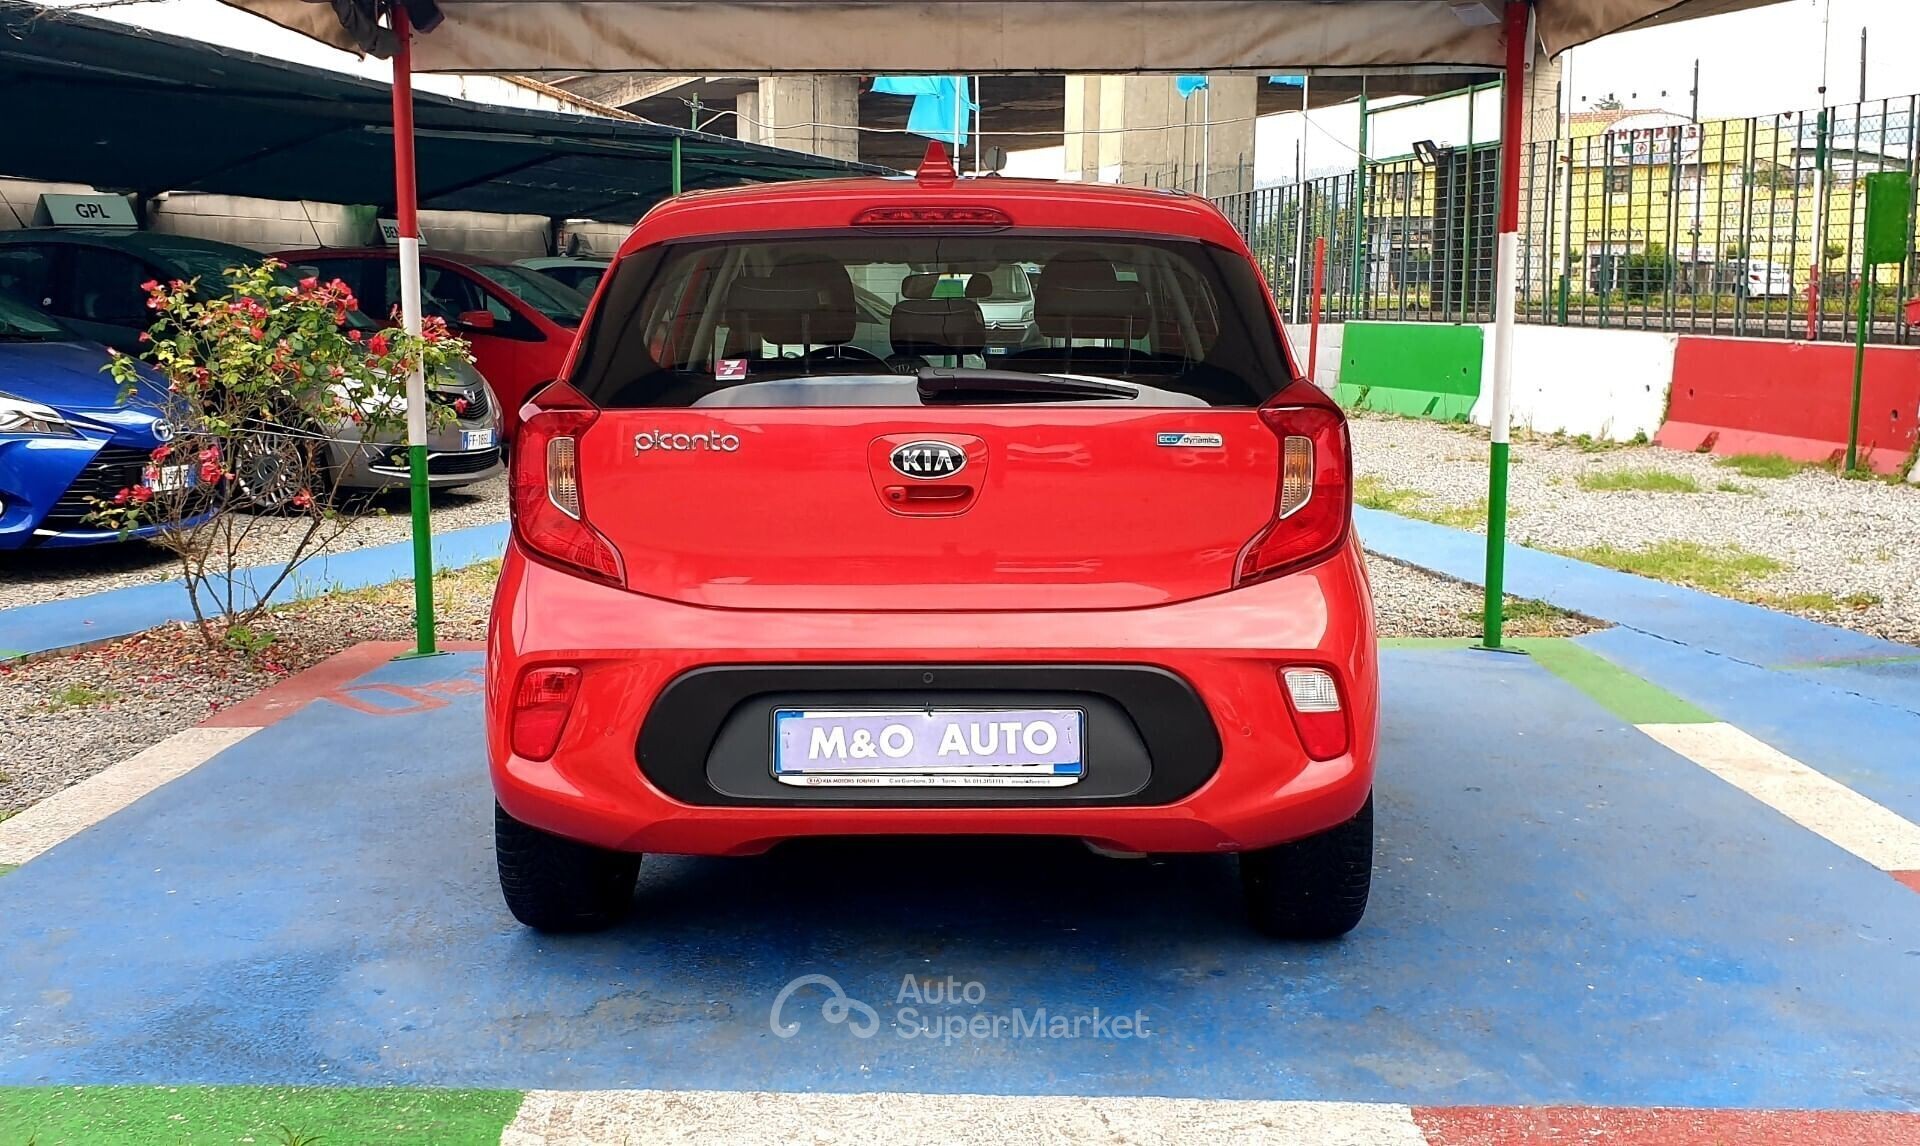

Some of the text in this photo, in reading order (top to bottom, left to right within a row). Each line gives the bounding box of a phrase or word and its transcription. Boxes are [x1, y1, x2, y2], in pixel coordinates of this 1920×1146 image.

[75, 203, 111, 219] GPL
[634, 429, 741, 458] picanto
[1159, 435, 1220, 445] ECO dynamics
[902, 449, 955, 472] KIA
[808, 720, 1059, 760] M&O AUTO
